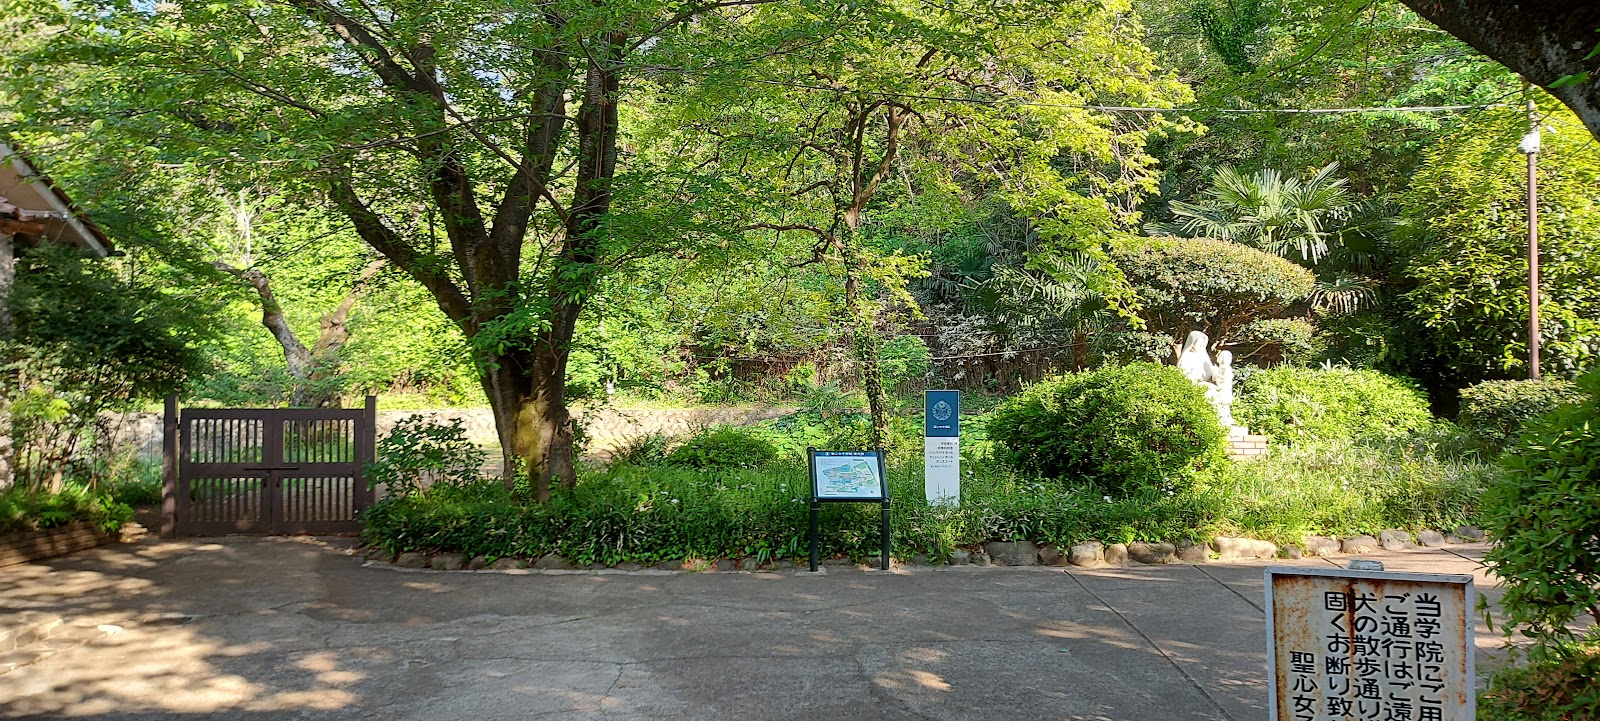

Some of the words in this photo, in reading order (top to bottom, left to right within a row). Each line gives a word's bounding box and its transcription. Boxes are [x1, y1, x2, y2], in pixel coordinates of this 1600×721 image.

[1324, 591, 1354, 721] 固くお断り致
[1352, 592, 1381, 721] 犬の散歩通り
[1380, 592, 1415, 721] ご通行はご遠
[1414, 592, 1445, 721] 当学院にご用
